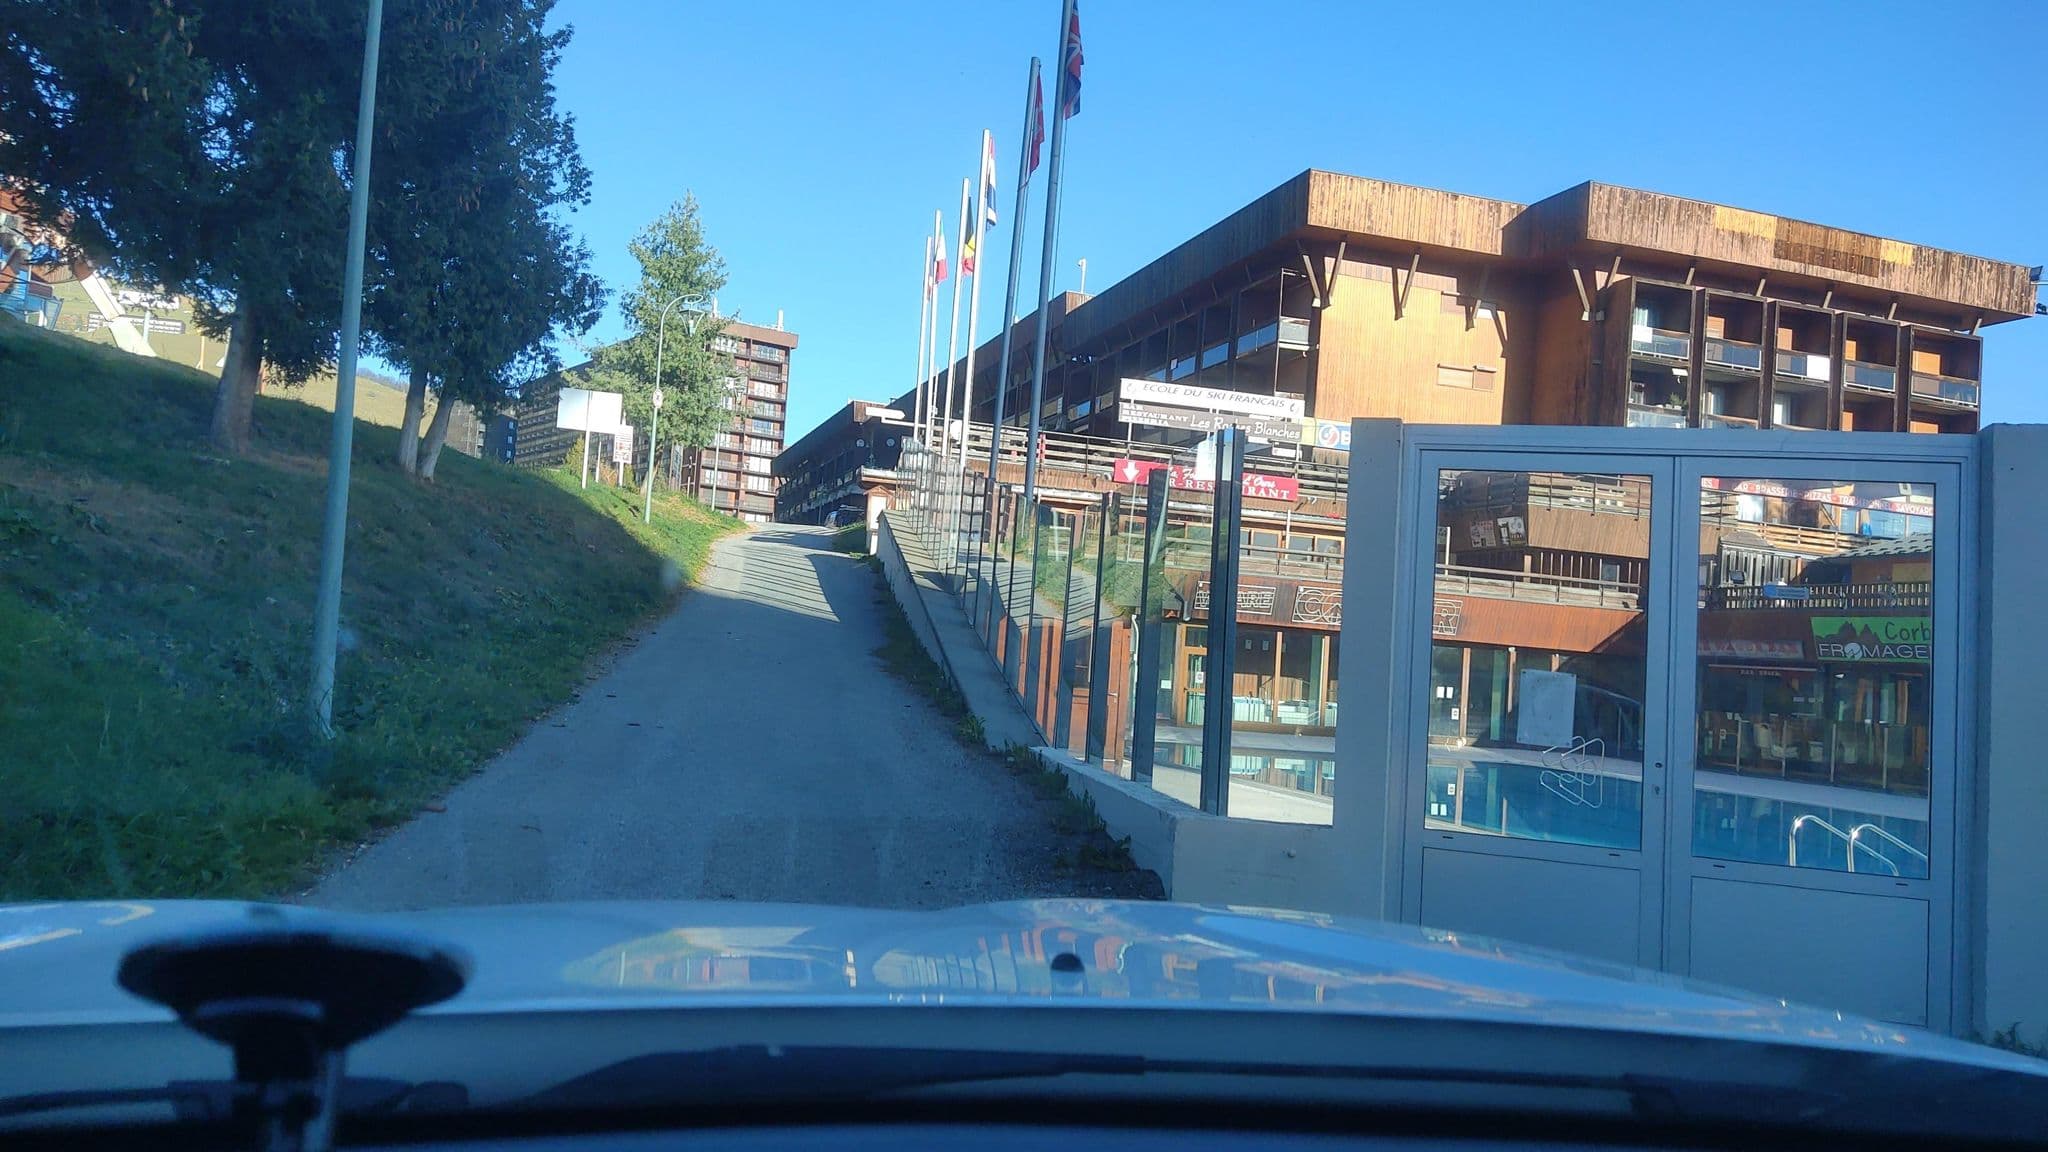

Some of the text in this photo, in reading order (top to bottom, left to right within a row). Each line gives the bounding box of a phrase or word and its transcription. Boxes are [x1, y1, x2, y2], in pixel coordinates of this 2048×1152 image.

[1143, 383, 1180, 395] ECOLE
[1183, 388, 1203, 398] DU
[1207, 390, 1227, 400] SKI
[1190, 414, 1211, 429] Les
[1254, 420, 1301, 439] Blanches
